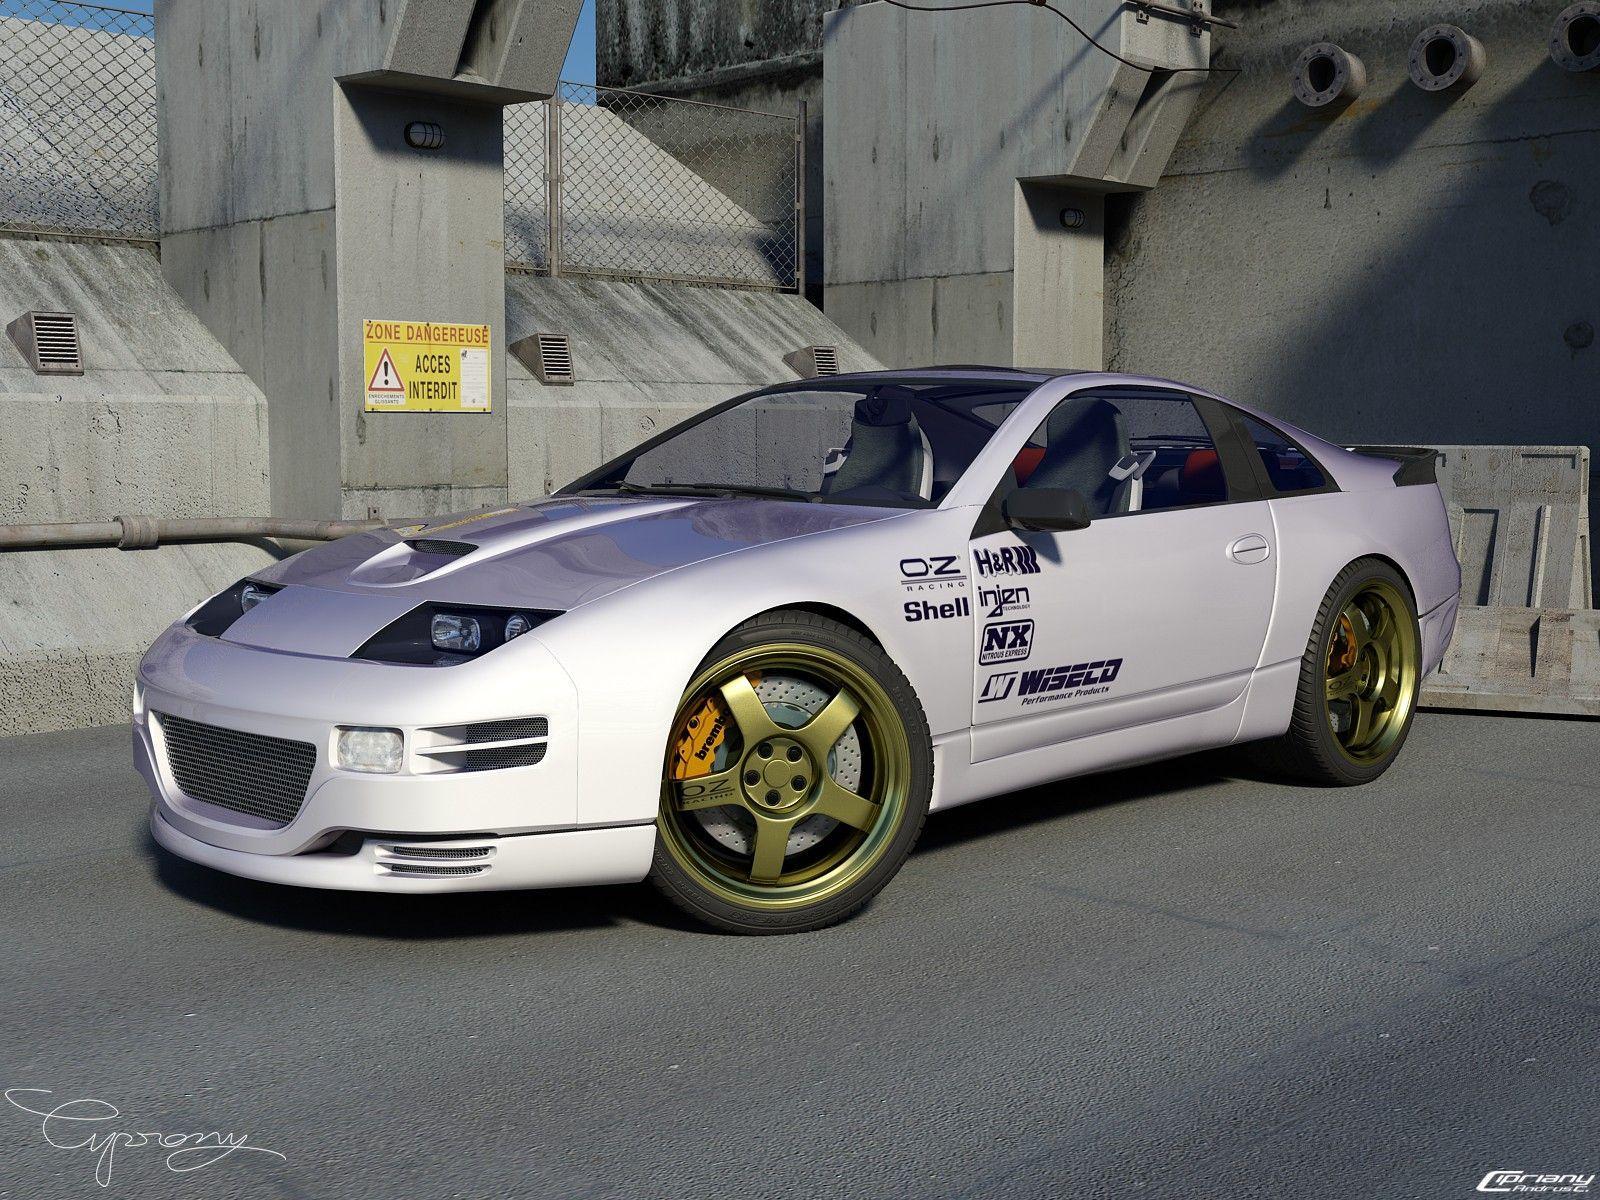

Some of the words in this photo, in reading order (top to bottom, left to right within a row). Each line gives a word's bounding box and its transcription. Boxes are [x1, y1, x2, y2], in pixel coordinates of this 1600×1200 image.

[366, 323, 401, 340] ZONE
[406, 325, 489, 344] DANGEREUSE
[415, 354, 451, 374] ACCES
[409, 381, 458, 399] INTERDIT
[906, 581, 965, 592] RACING
[904, 596, 970, 622] Shell
[977, 584, 1030, 618] injen
[983, 623, 1032, 652] NX
[981, 650, 1005, 661] NITROUS
[1004, 647, 1028, 658] EXPRESS
[1021, 691, 1073, 706] Performance
[1074, 685, 1110, 697] Products
